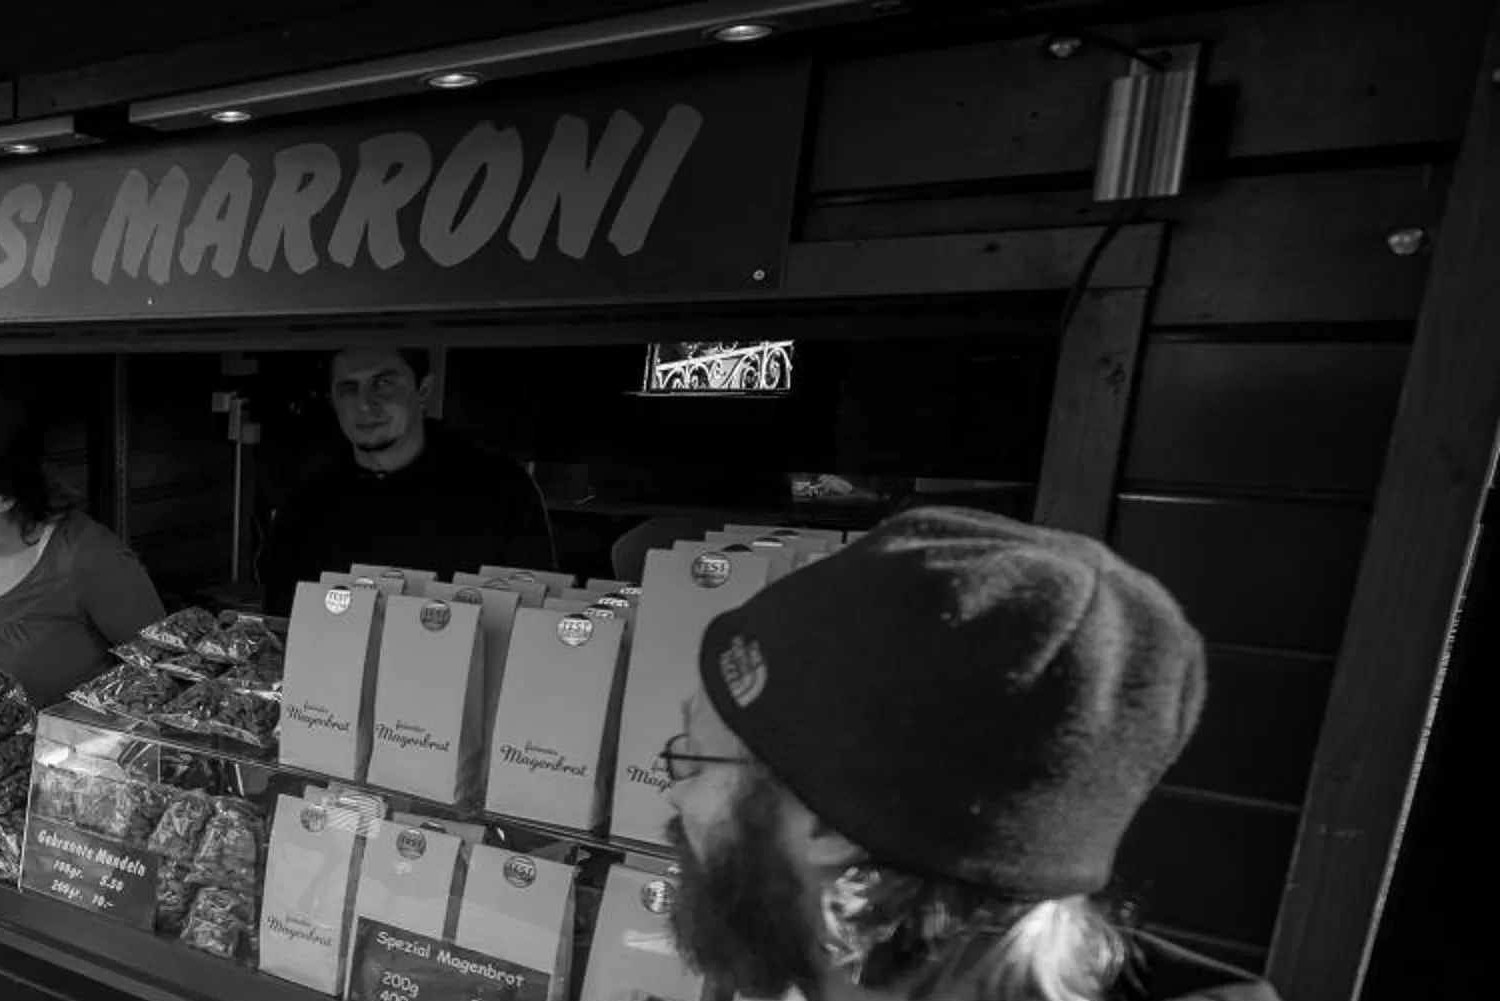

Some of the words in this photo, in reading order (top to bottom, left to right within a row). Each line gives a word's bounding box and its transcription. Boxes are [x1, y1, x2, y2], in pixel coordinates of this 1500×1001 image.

[91, 102, 704, 286] MARRONI
[286, 704, 350, 731] Magenbrot
[375, 723, 451, 752] Magenbrot
[500, 745, 588, 777] Magenbrot
[95, 847, 147, 878] Mandeln
[376, 931, 431, 959] Spezial
[436, 948, 527, 989] Magenbrot
[381, 970, 420, 999] 200g
